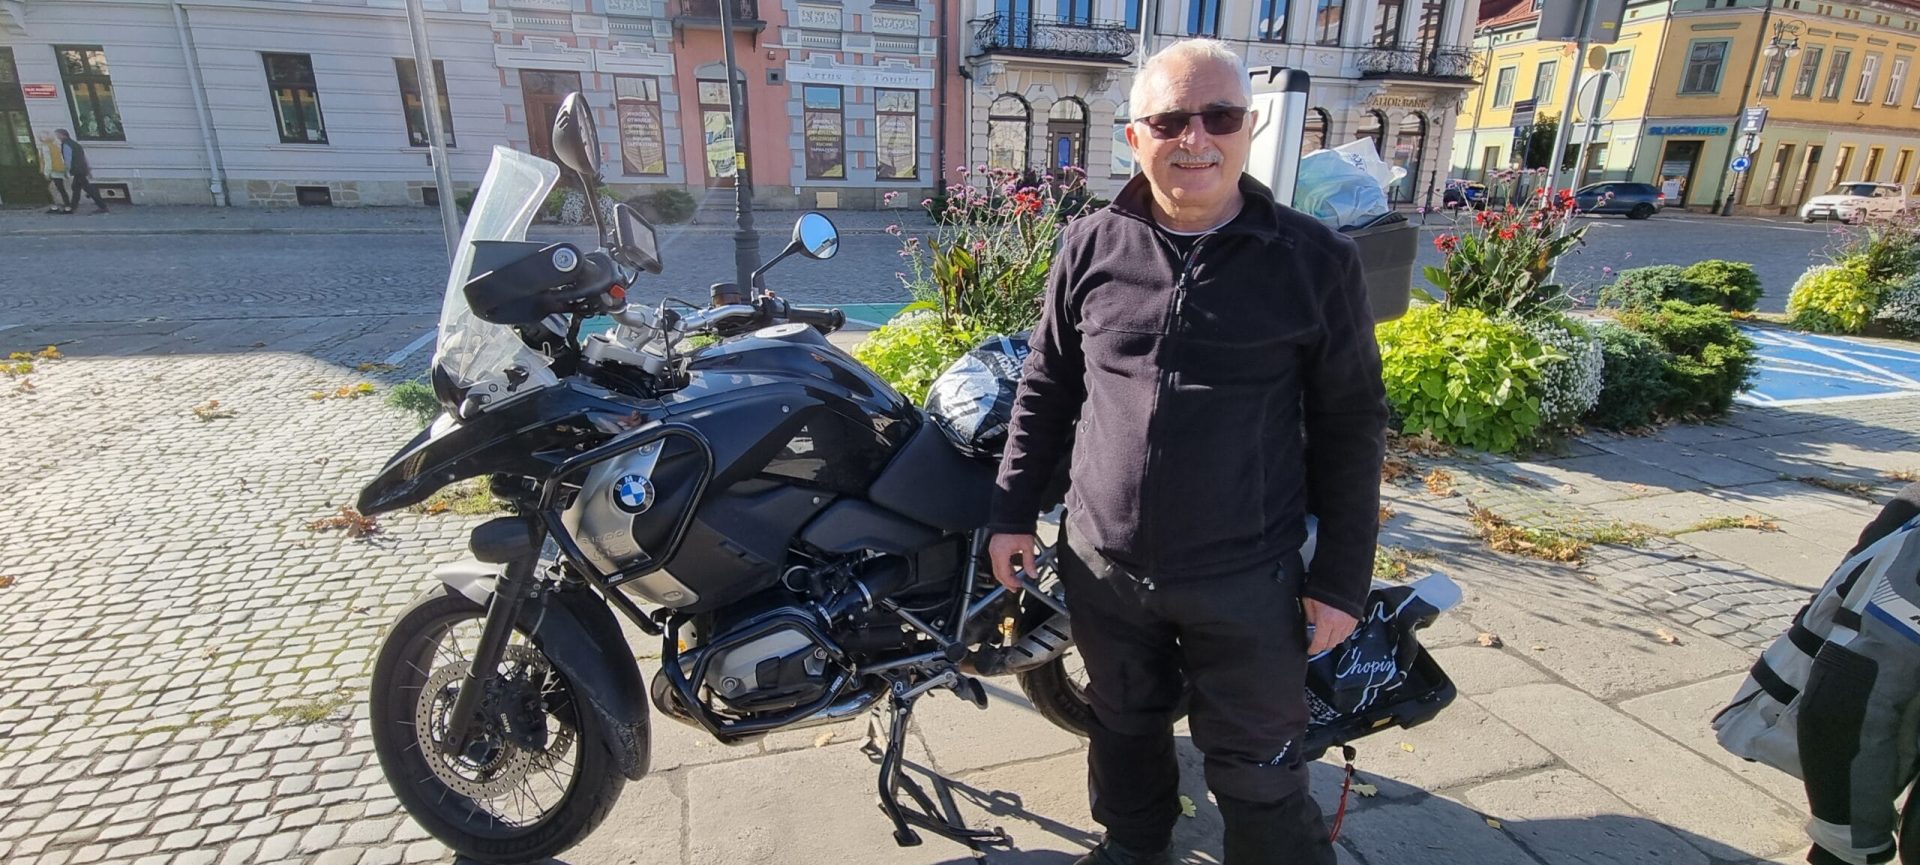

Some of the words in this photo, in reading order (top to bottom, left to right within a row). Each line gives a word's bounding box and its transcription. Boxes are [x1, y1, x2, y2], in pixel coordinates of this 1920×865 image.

[1403, 97, 1428, 108] BANK
[615, 475, 648, 491] BMW
[1336, 646, 1396, 687] Chopin
[500, 712, 512, 733] BMW
